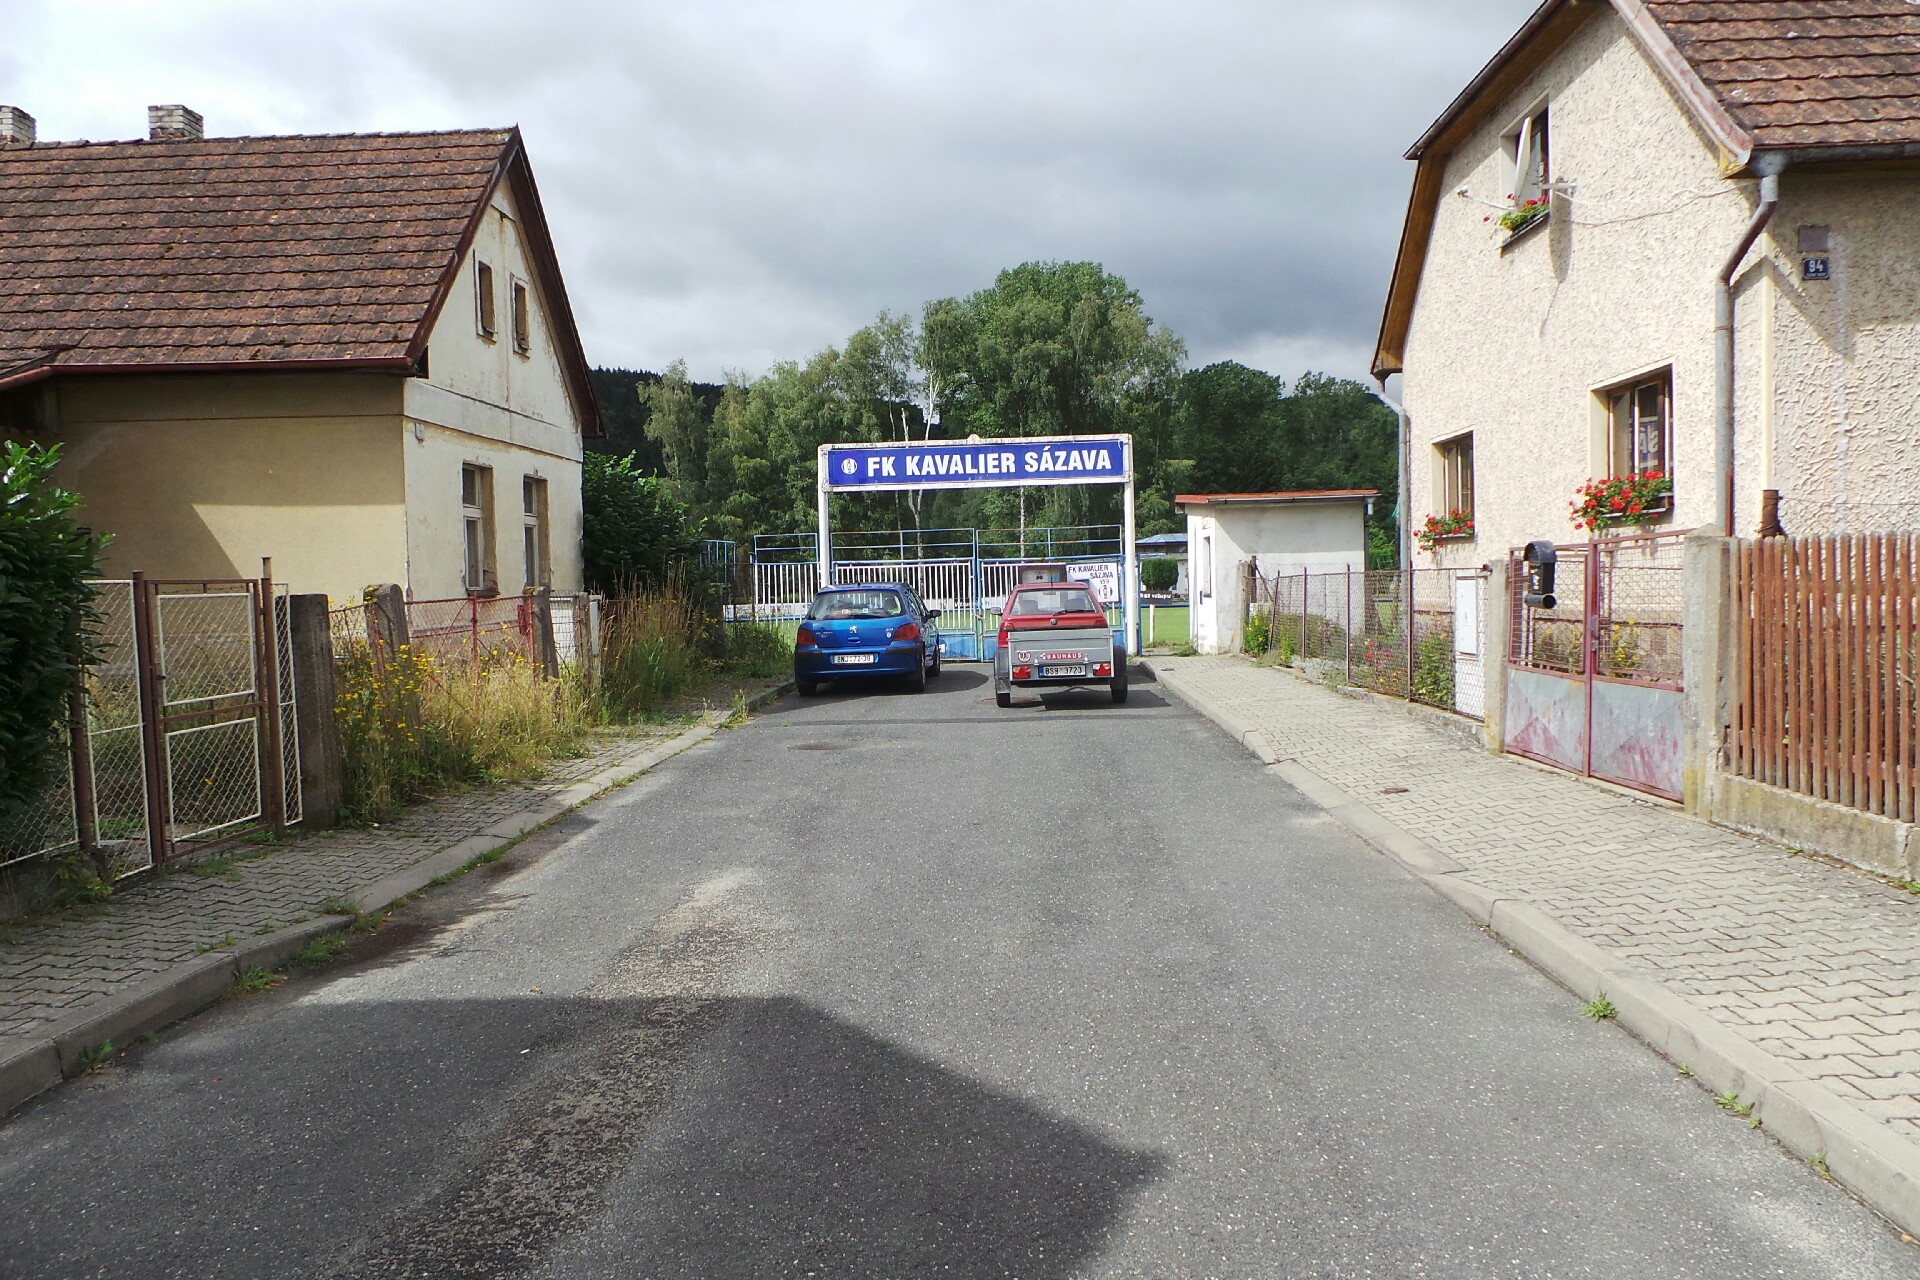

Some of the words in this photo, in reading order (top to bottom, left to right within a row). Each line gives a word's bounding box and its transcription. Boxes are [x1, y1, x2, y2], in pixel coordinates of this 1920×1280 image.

[1809, 260, 1824, 272] 94
[867, 456, 896, 477] FK
[906, 453, 1016, 476] KAVALIER
[1024, 446, 1112, 472] SÁZAVA
[1068, 566, 1077, 574] FK
